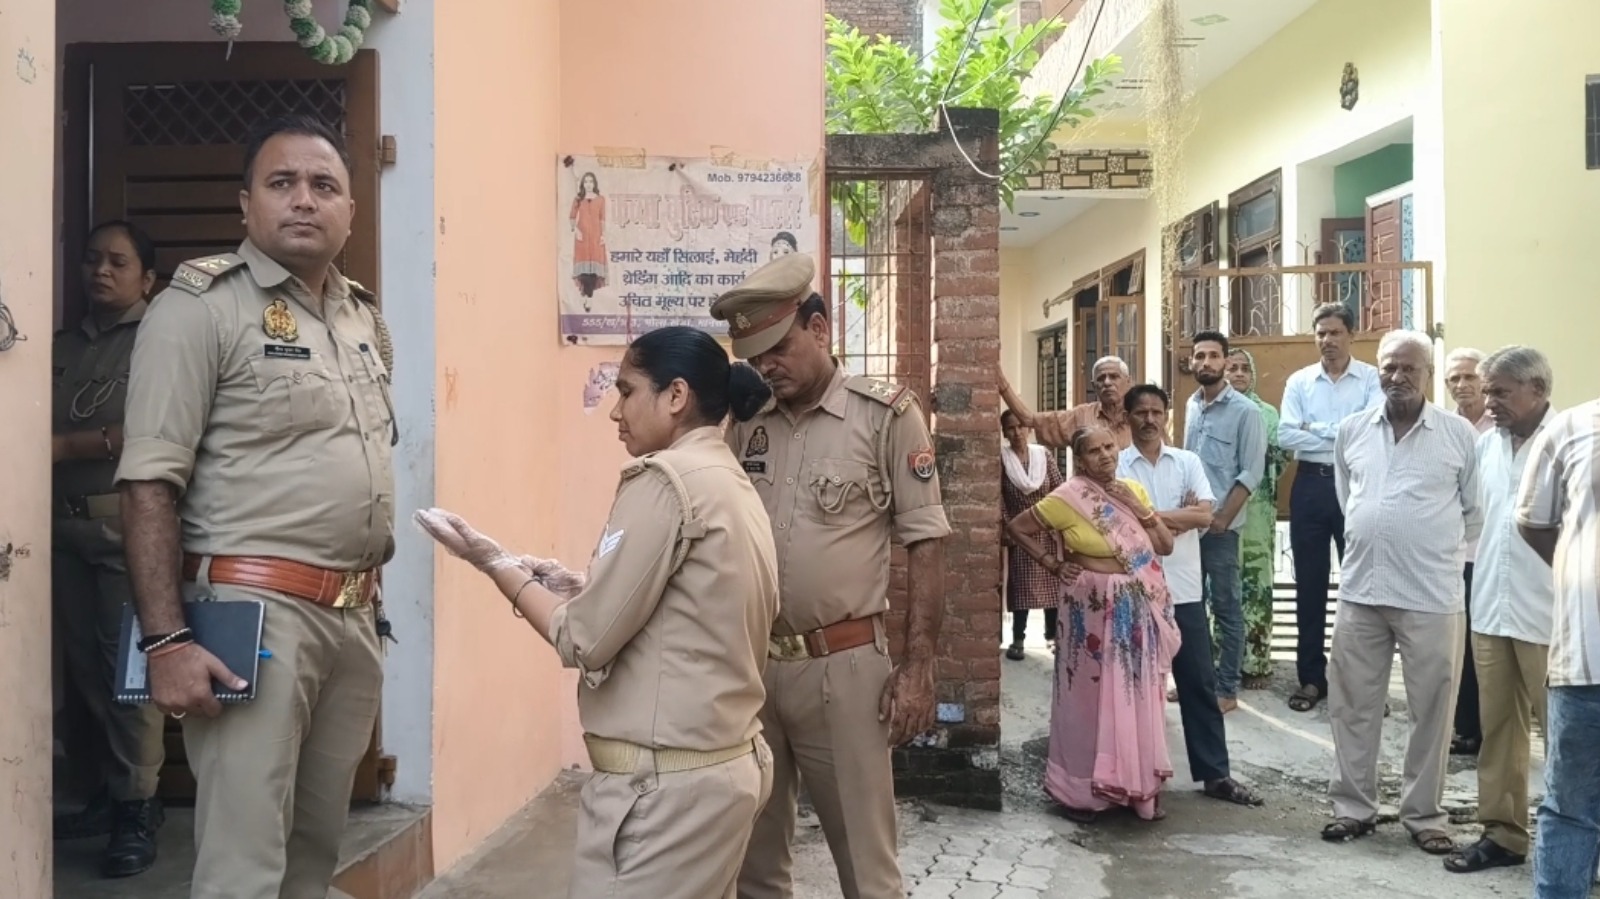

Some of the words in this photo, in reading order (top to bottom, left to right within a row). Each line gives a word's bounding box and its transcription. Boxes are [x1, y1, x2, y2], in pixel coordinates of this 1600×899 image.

[707, 173, 734, 182] Mob.
[610, 248, 643, 263] हमारे
[645, 247, 671, 263] यहाँ
[673, 248, 720, 265] सिलाई,
[661, 270, 692, 286] आदि
[695, 274, 714, 286] का
[618, 292, 652, 307] उचित
[655, 294, 684, 311] मूल्य
[688, 295, 705, 307] पर
